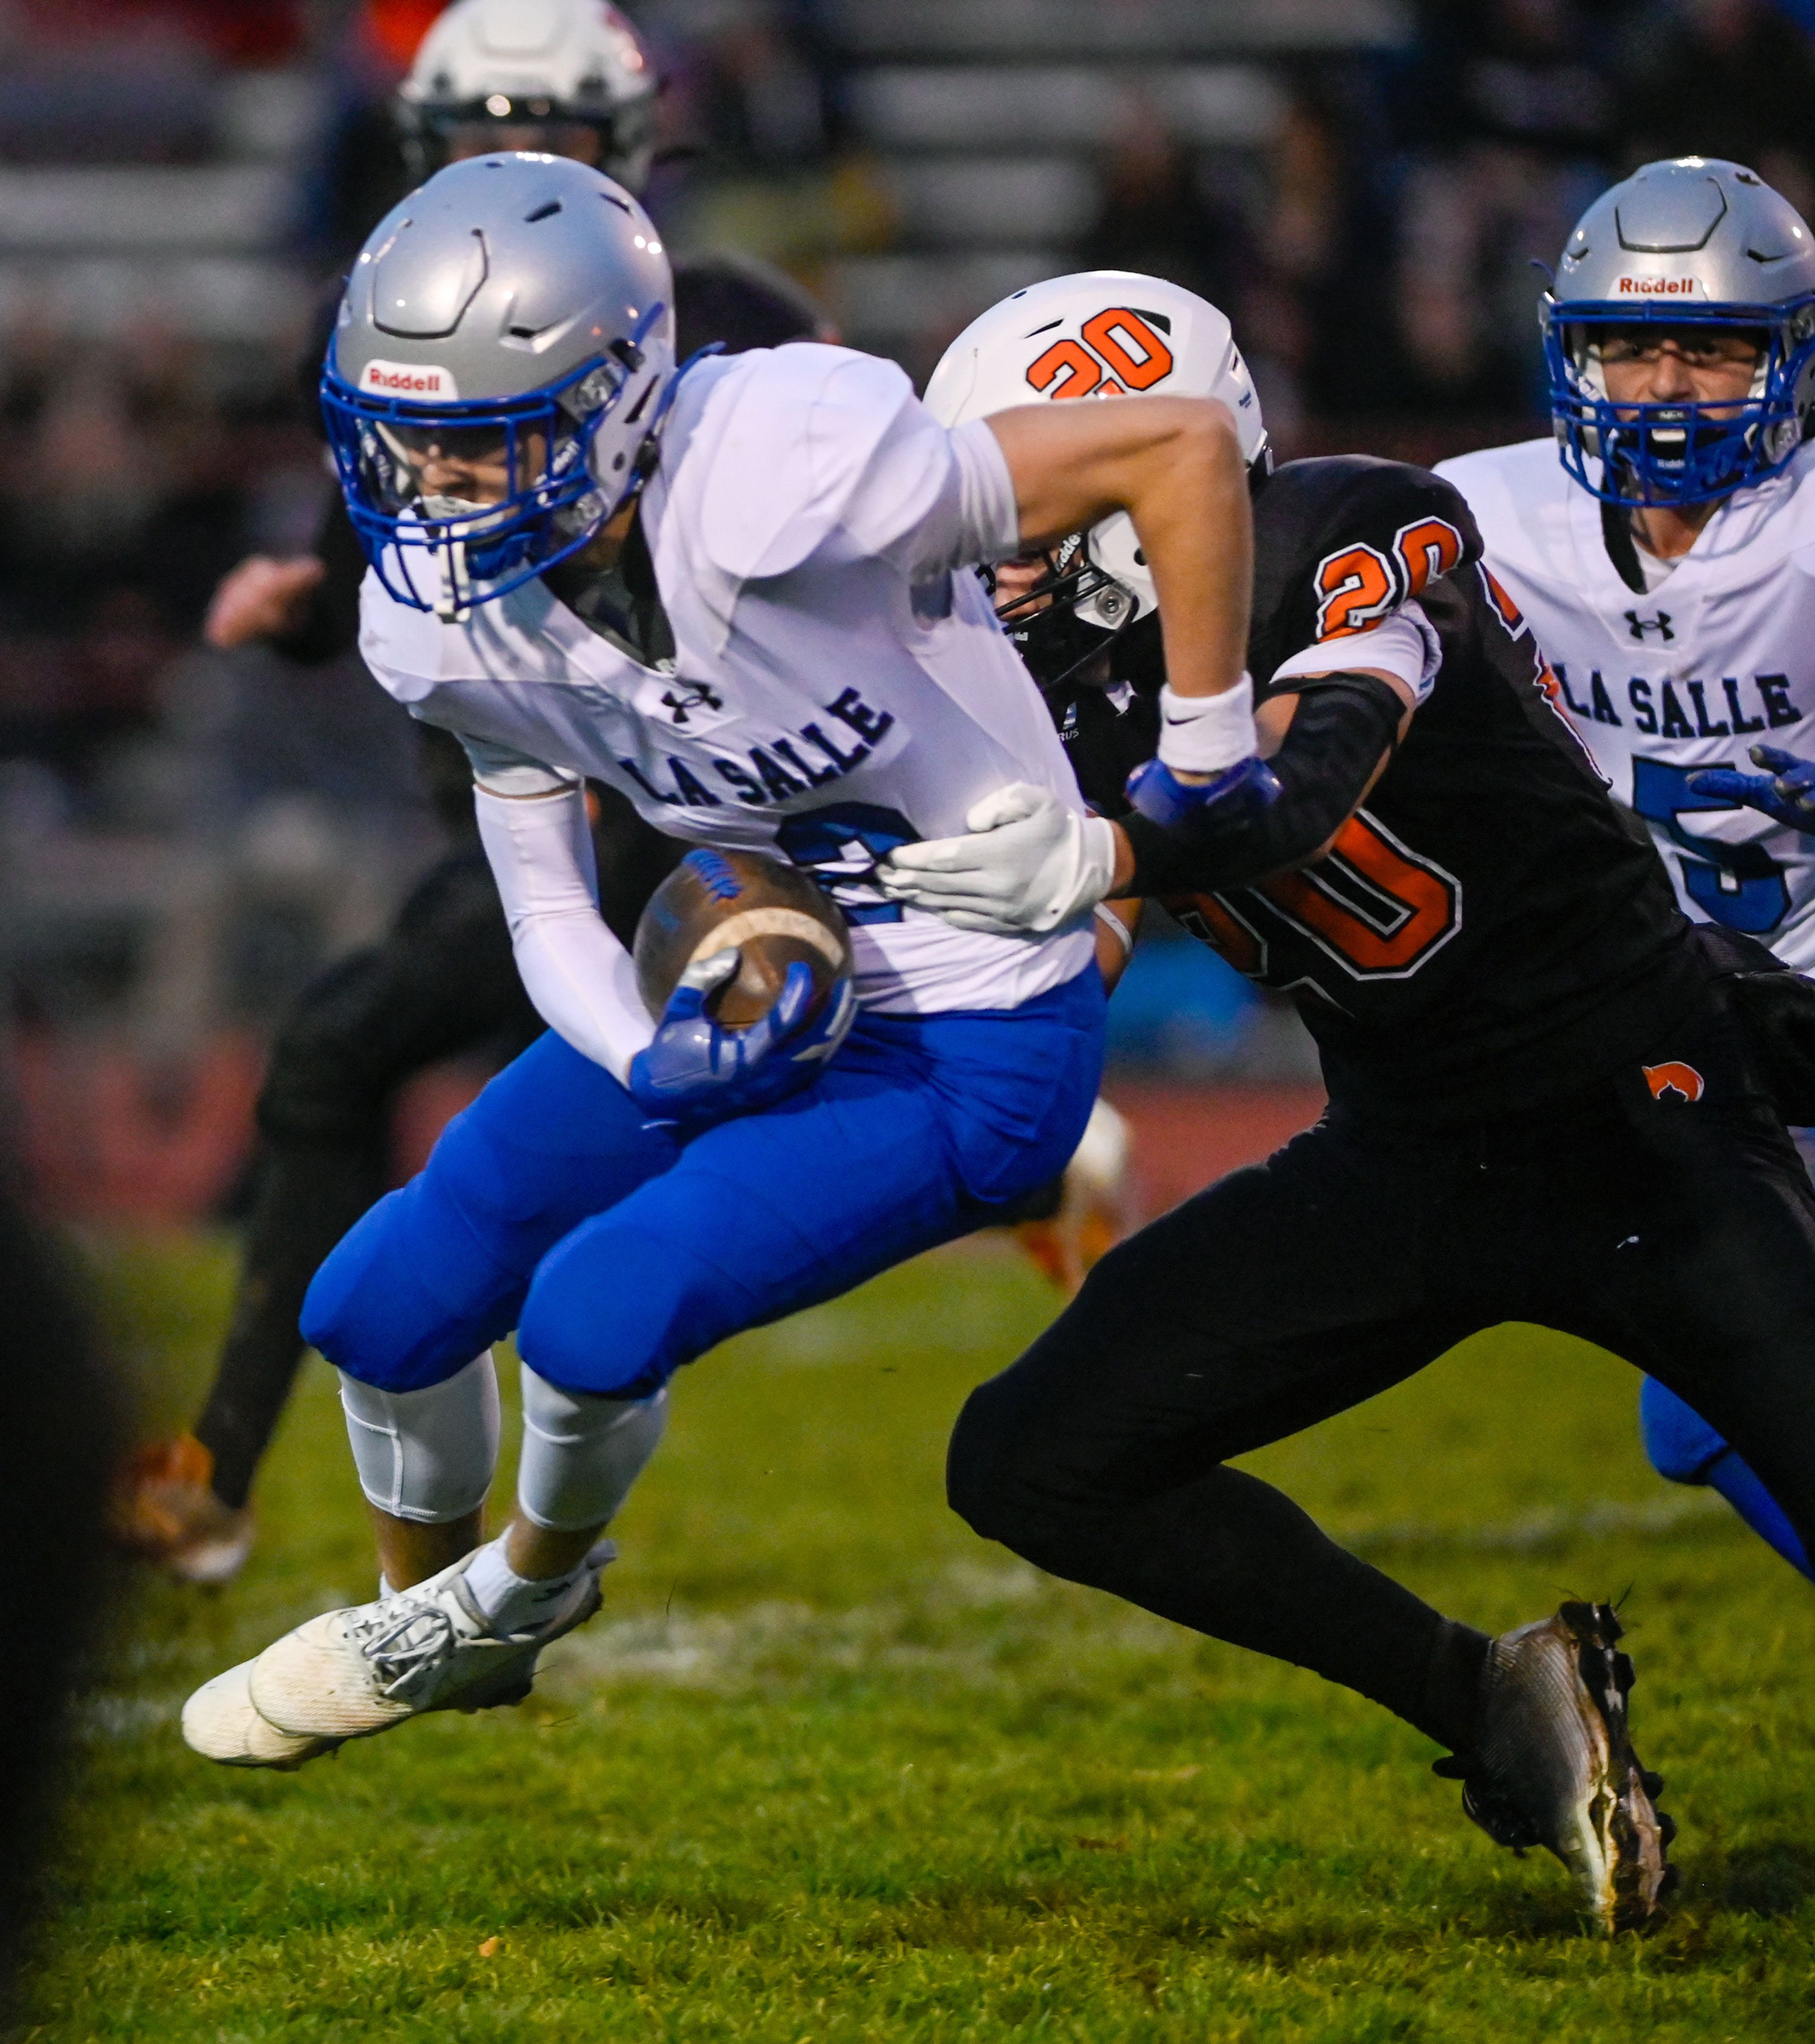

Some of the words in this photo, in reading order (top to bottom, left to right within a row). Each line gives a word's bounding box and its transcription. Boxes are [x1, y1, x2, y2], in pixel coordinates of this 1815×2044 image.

[1619, 277, 1694, 294] Riddell
[370, 367, 440, 391] Riddell
[1026, 306, 1174, 399] 20
[618, 756, 722, 805] LA
[713, 686, 895, 805] SALLE
[1551, 662, 1623, 727] LA
[1628, 672, 1803, 737] SALLE
[1632, 754, 1792, 935] 5
[1160, 807, 1463, 981] 0
